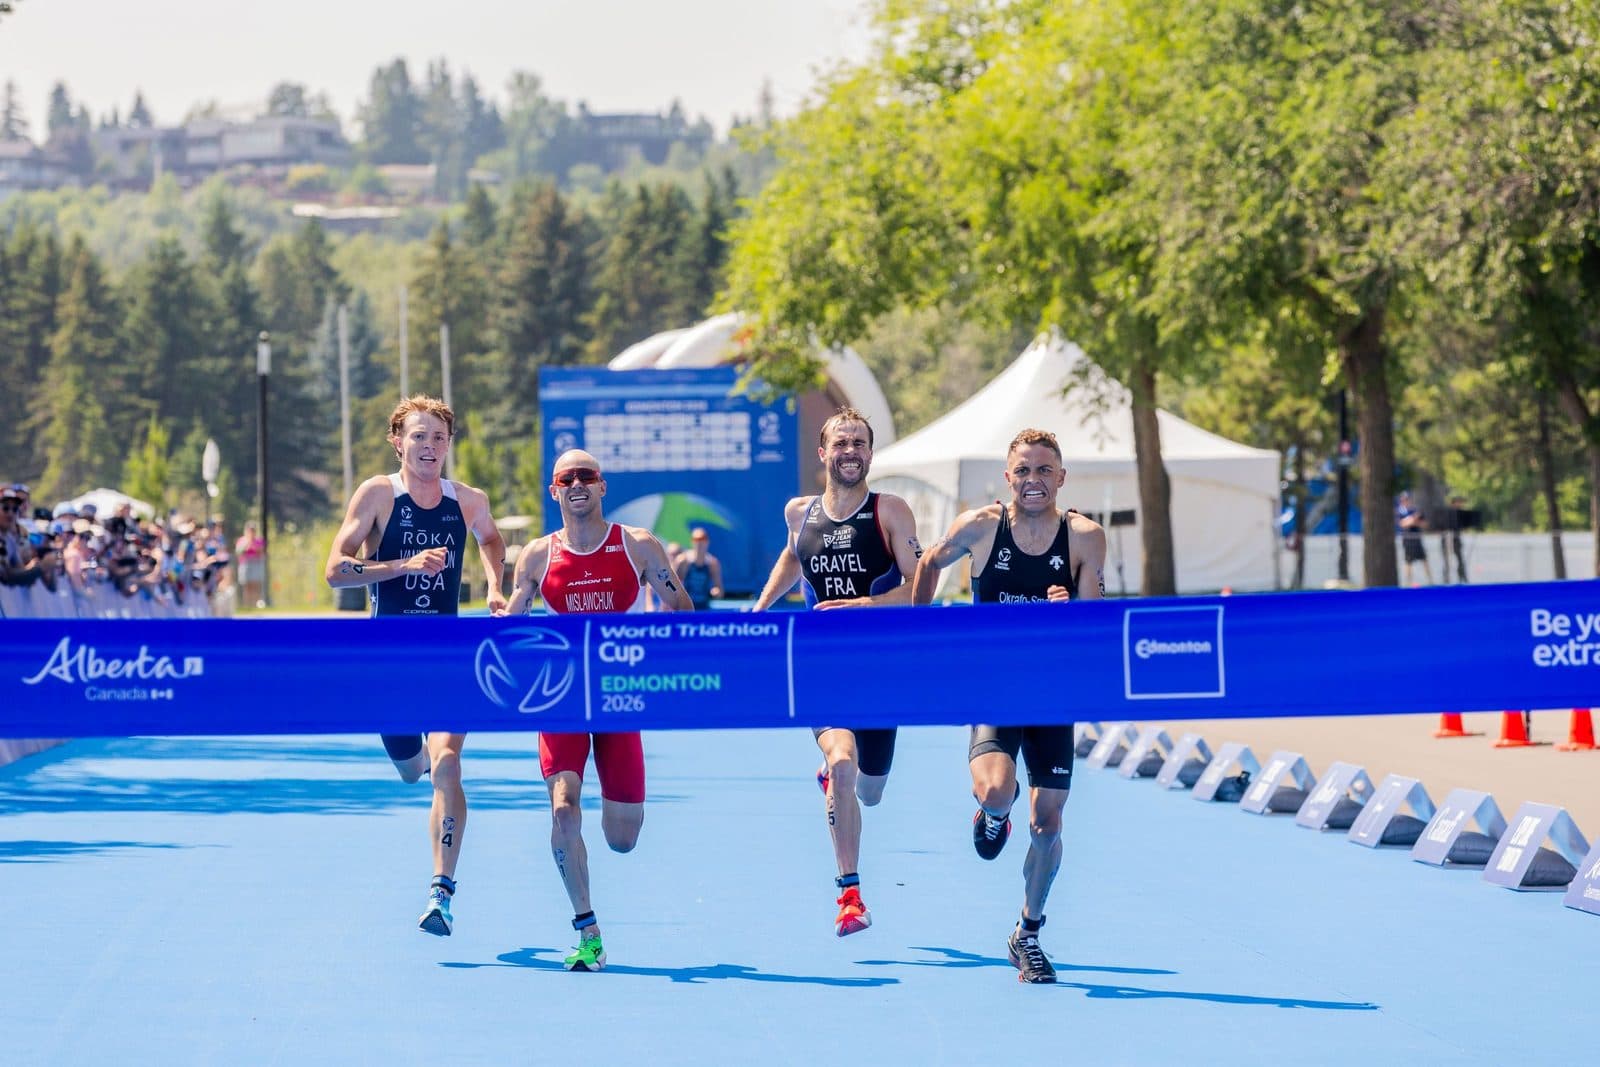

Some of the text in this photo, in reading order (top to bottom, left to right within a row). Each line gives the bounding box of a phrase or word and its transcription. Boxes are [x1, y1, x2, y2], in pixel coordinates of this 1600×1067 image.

[810, 553, 867, 574] GRAYEL
[405, 571, 445, 591] USA
[824, 577, 857, 597] FRA
[565, 591, 615, 612] MISLAWCHUK
[599, 623, 779, 639] World Triathlon
[1531, 608, 1571, 637] Be
[599, 641, 645, 666] Cup
[1135, 638, 1212, 659] Edmonton
[22, 636, 190, 684] Alberta
[601, 673, 721, 692] EDMONTON
[85, 685, 148, 701] Canada
[601, 694, 645, 712] 2026
[827, 811, 836, 826] 5
[441, 832, 453, 848] 4
